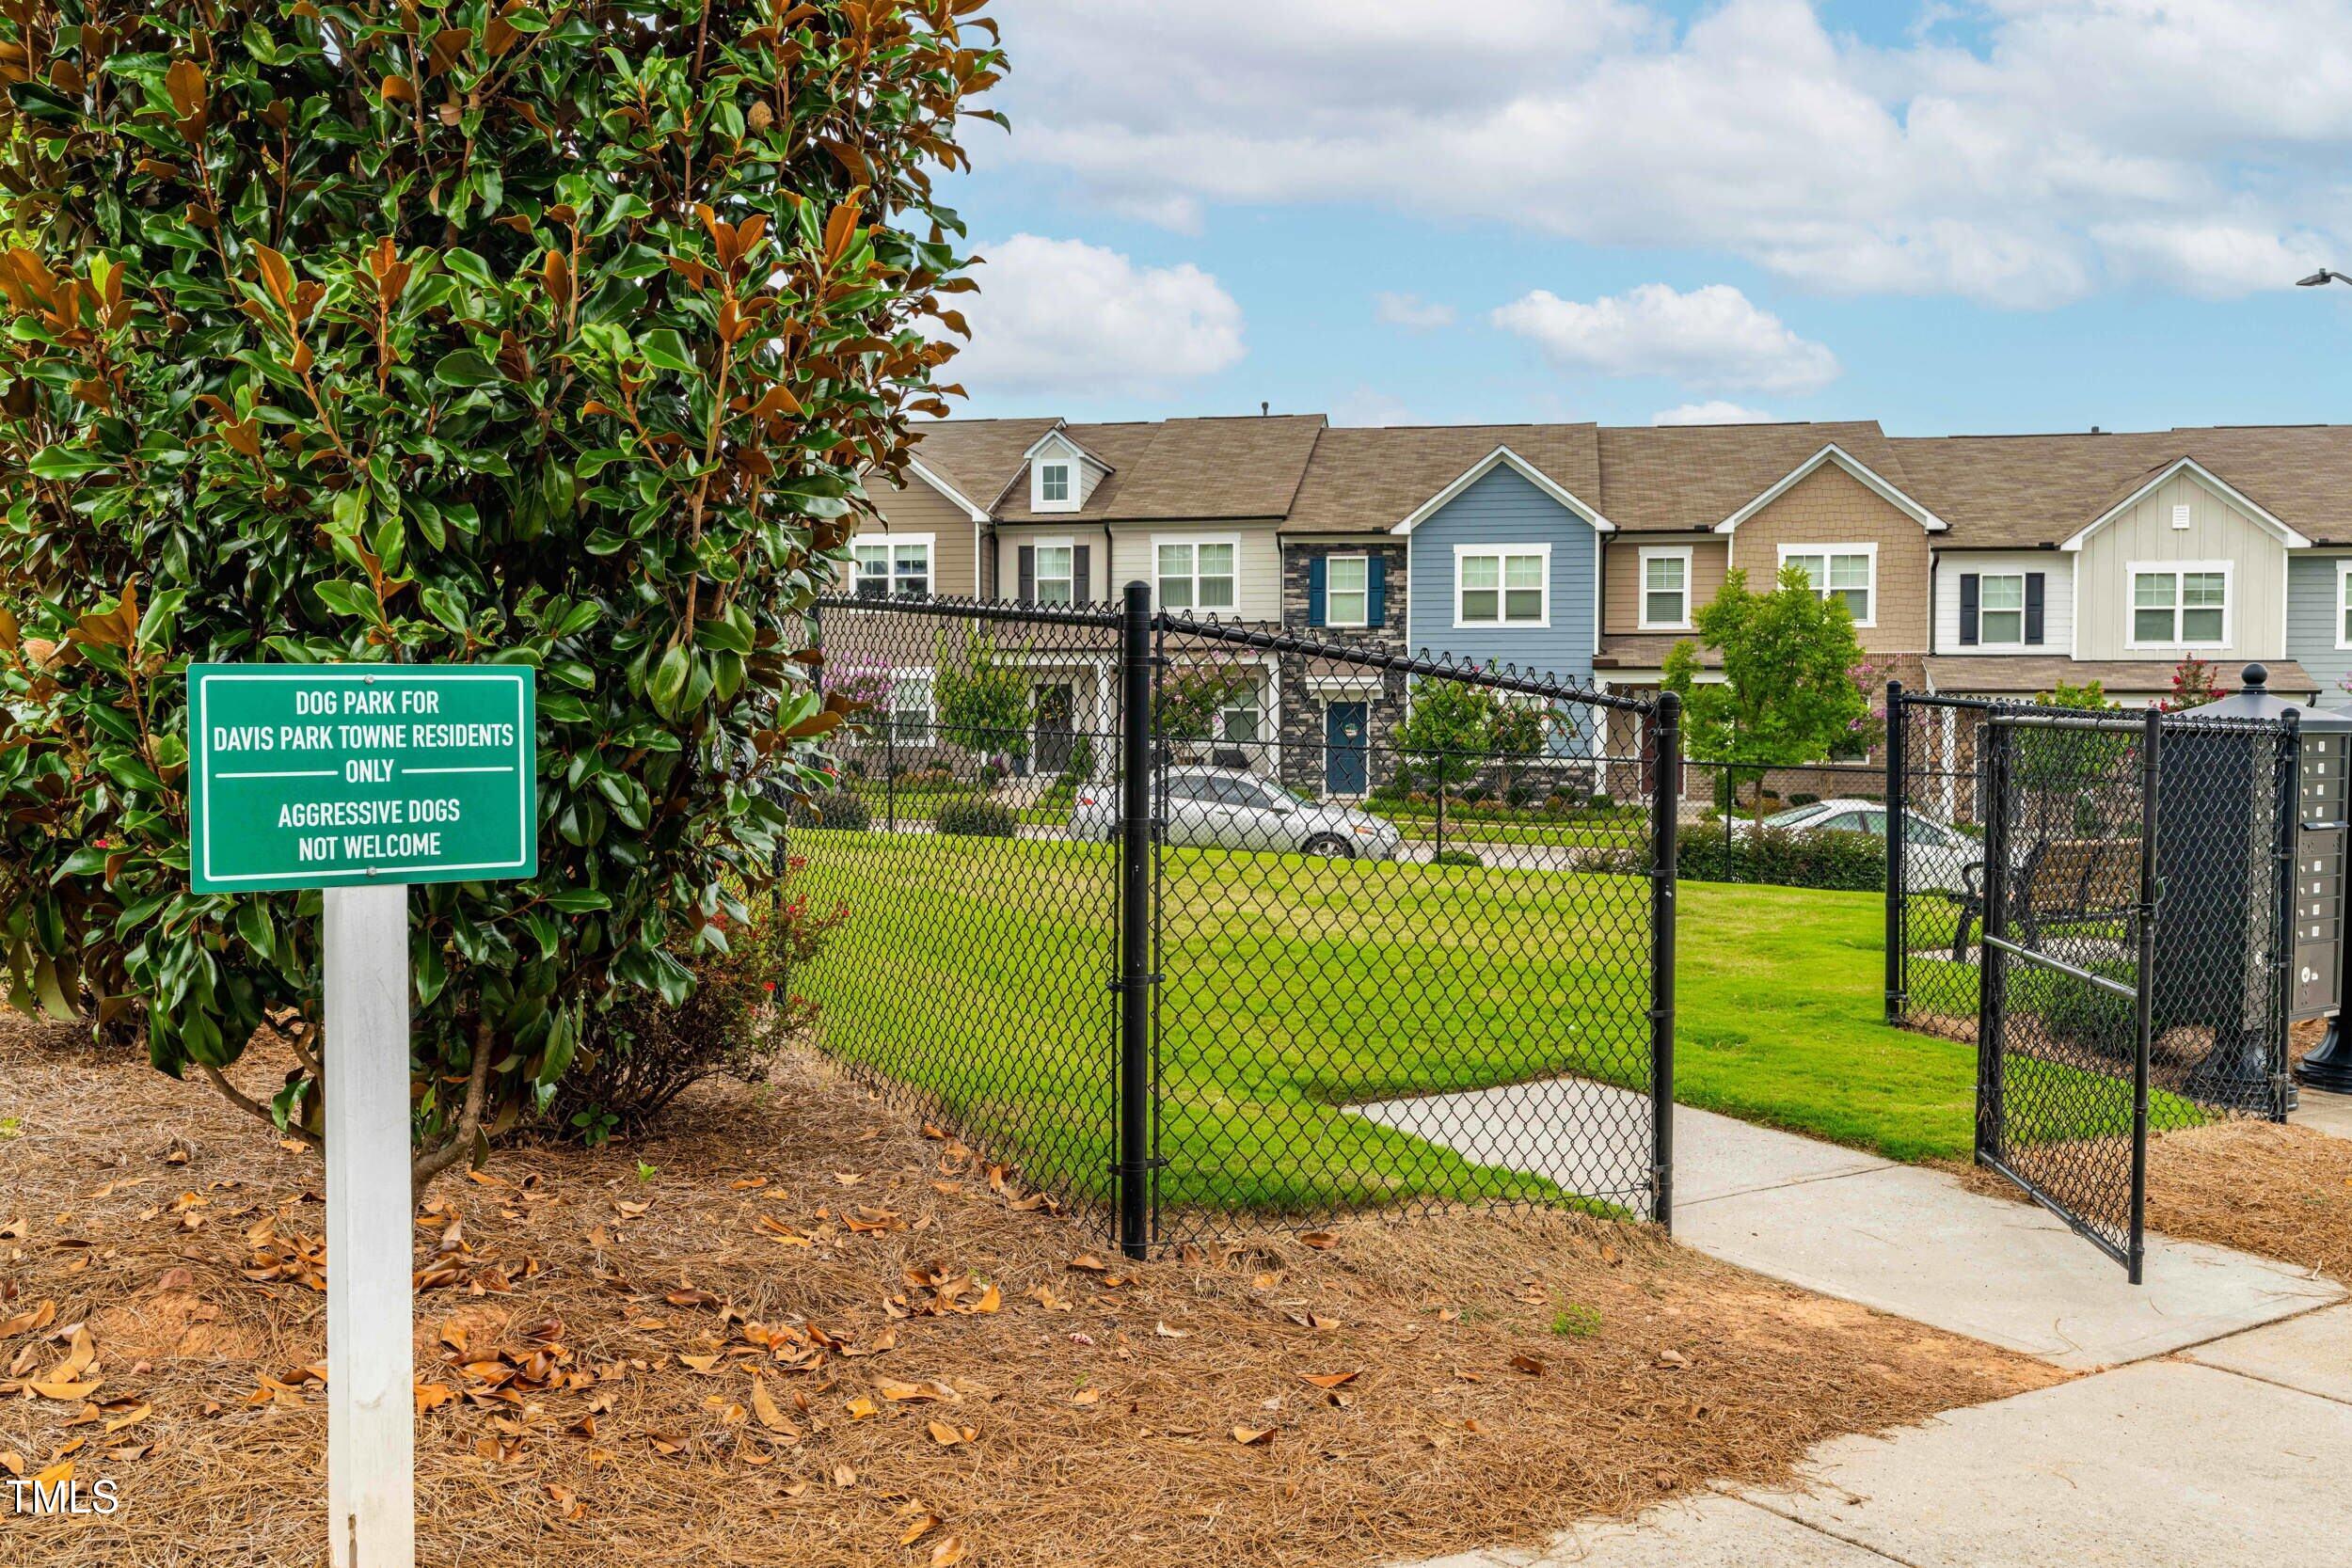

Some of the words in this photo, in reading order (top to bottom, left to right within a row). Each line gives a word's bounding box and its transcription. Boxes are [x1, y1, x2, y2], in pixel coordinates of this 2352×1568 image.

[296, 691, 337, 715] DOG
[344, 691, 395, 714] PARK
[403, 690, 439, 714] FOR
[214, 726, 274, 751] DAVIS
[281, 726, 333, 750] PARK
[339, 725, 406, 749] TOWNE
[413, 723, 514, 748] RESIDENTS
[345, 759, 394, 783] ONLY
[278, 800, 403, 828] AGGRESSIVE
[409, 799, 460, 823] DOGS
[299, 836, 339, 861] NOT
[344, 832, 441, 859] WELCOME
